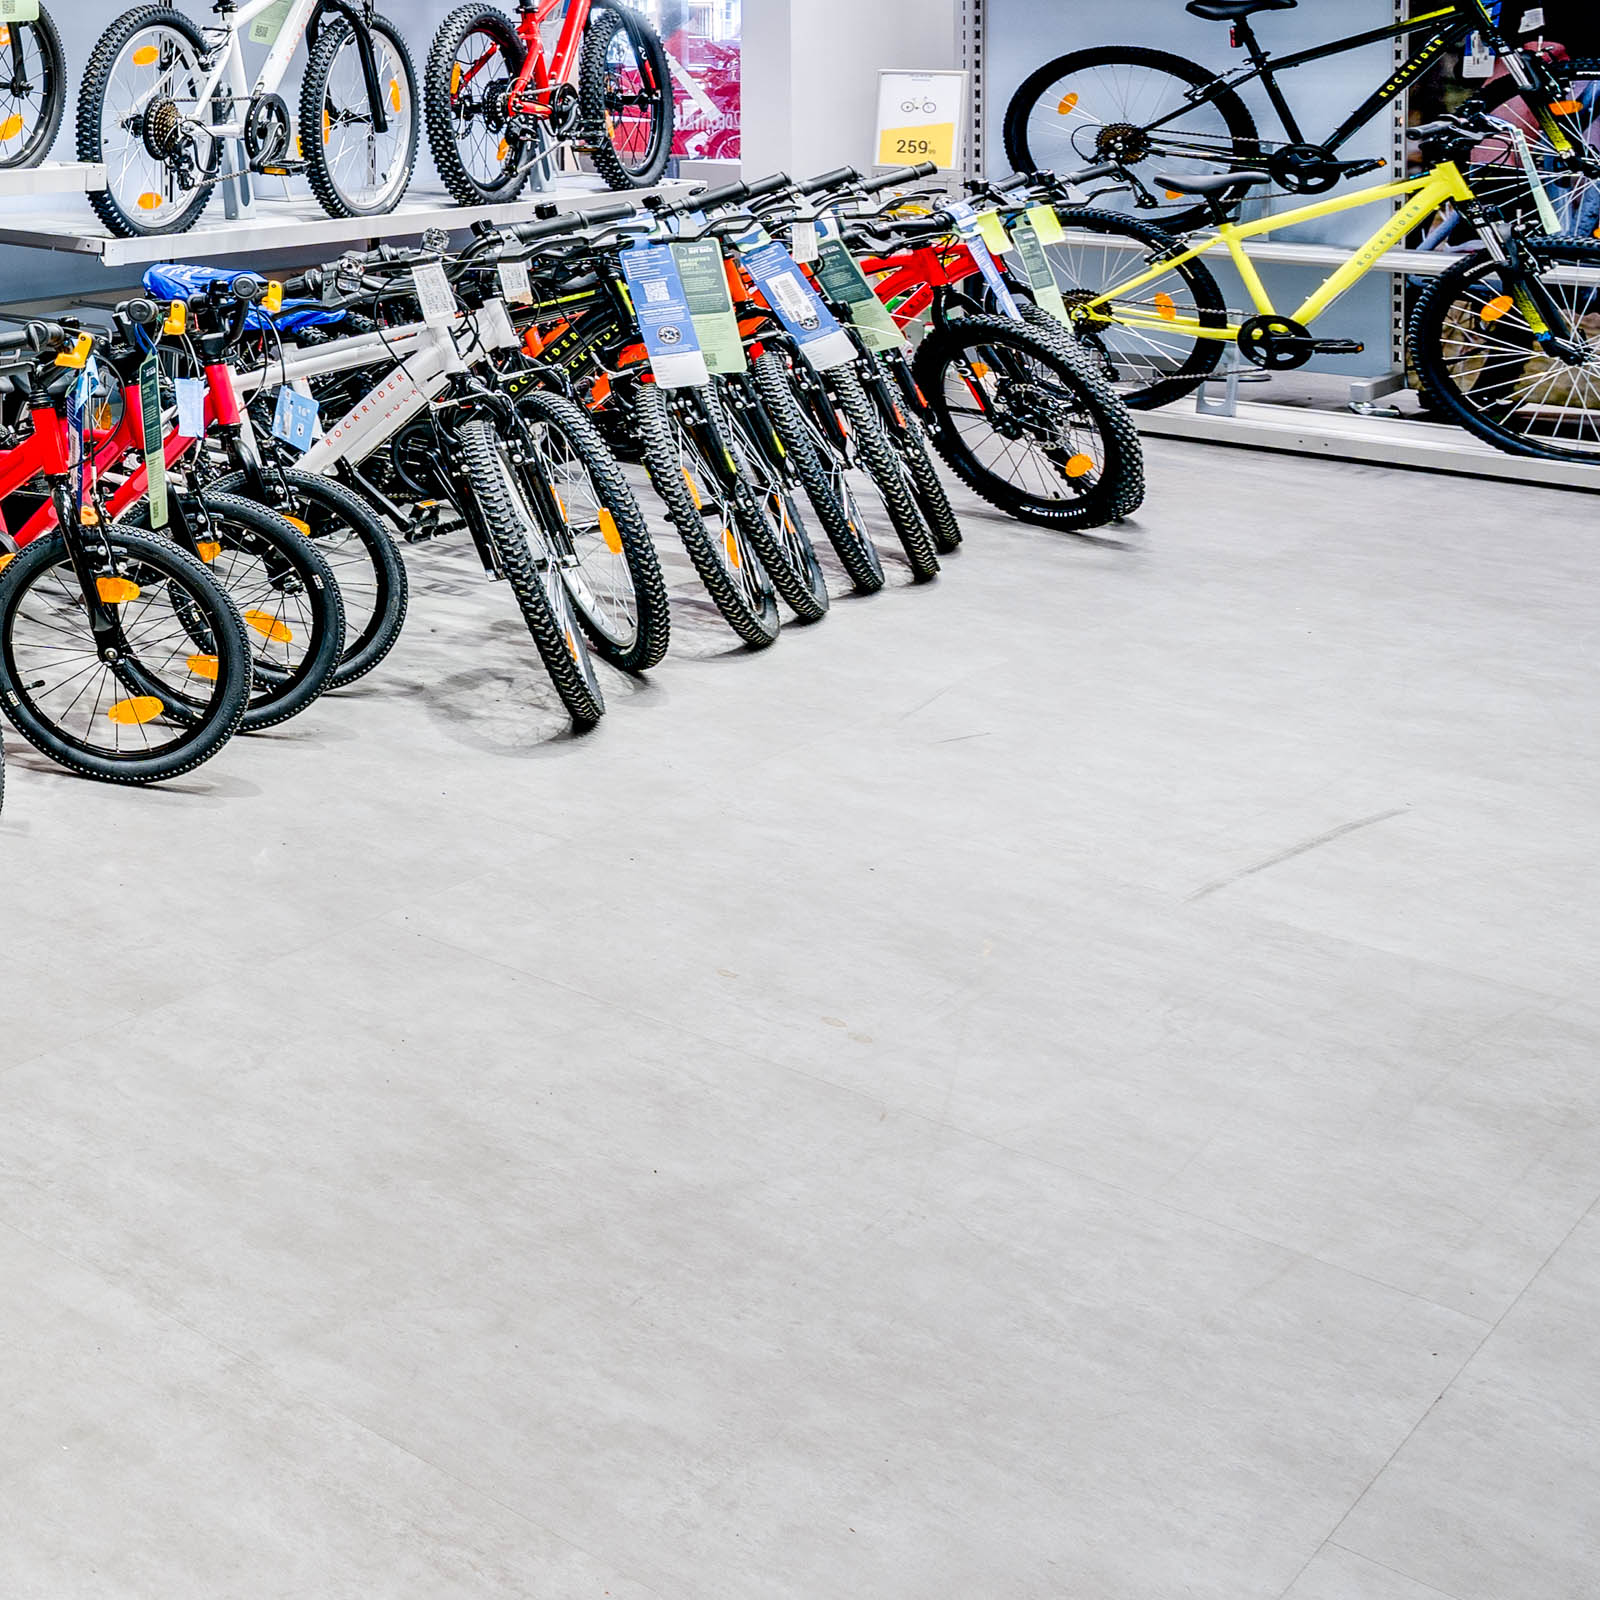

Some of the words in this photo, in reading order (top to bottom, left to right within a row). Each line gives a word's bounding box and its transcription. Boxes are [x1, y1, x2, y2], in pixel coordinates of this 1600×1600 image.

[1379, 39, 1444, 97] ROCKRIDER
[1357, 206, 1420, 266] ROCKRIDER
[325, 374, 404, 446] ROCKRIDER
